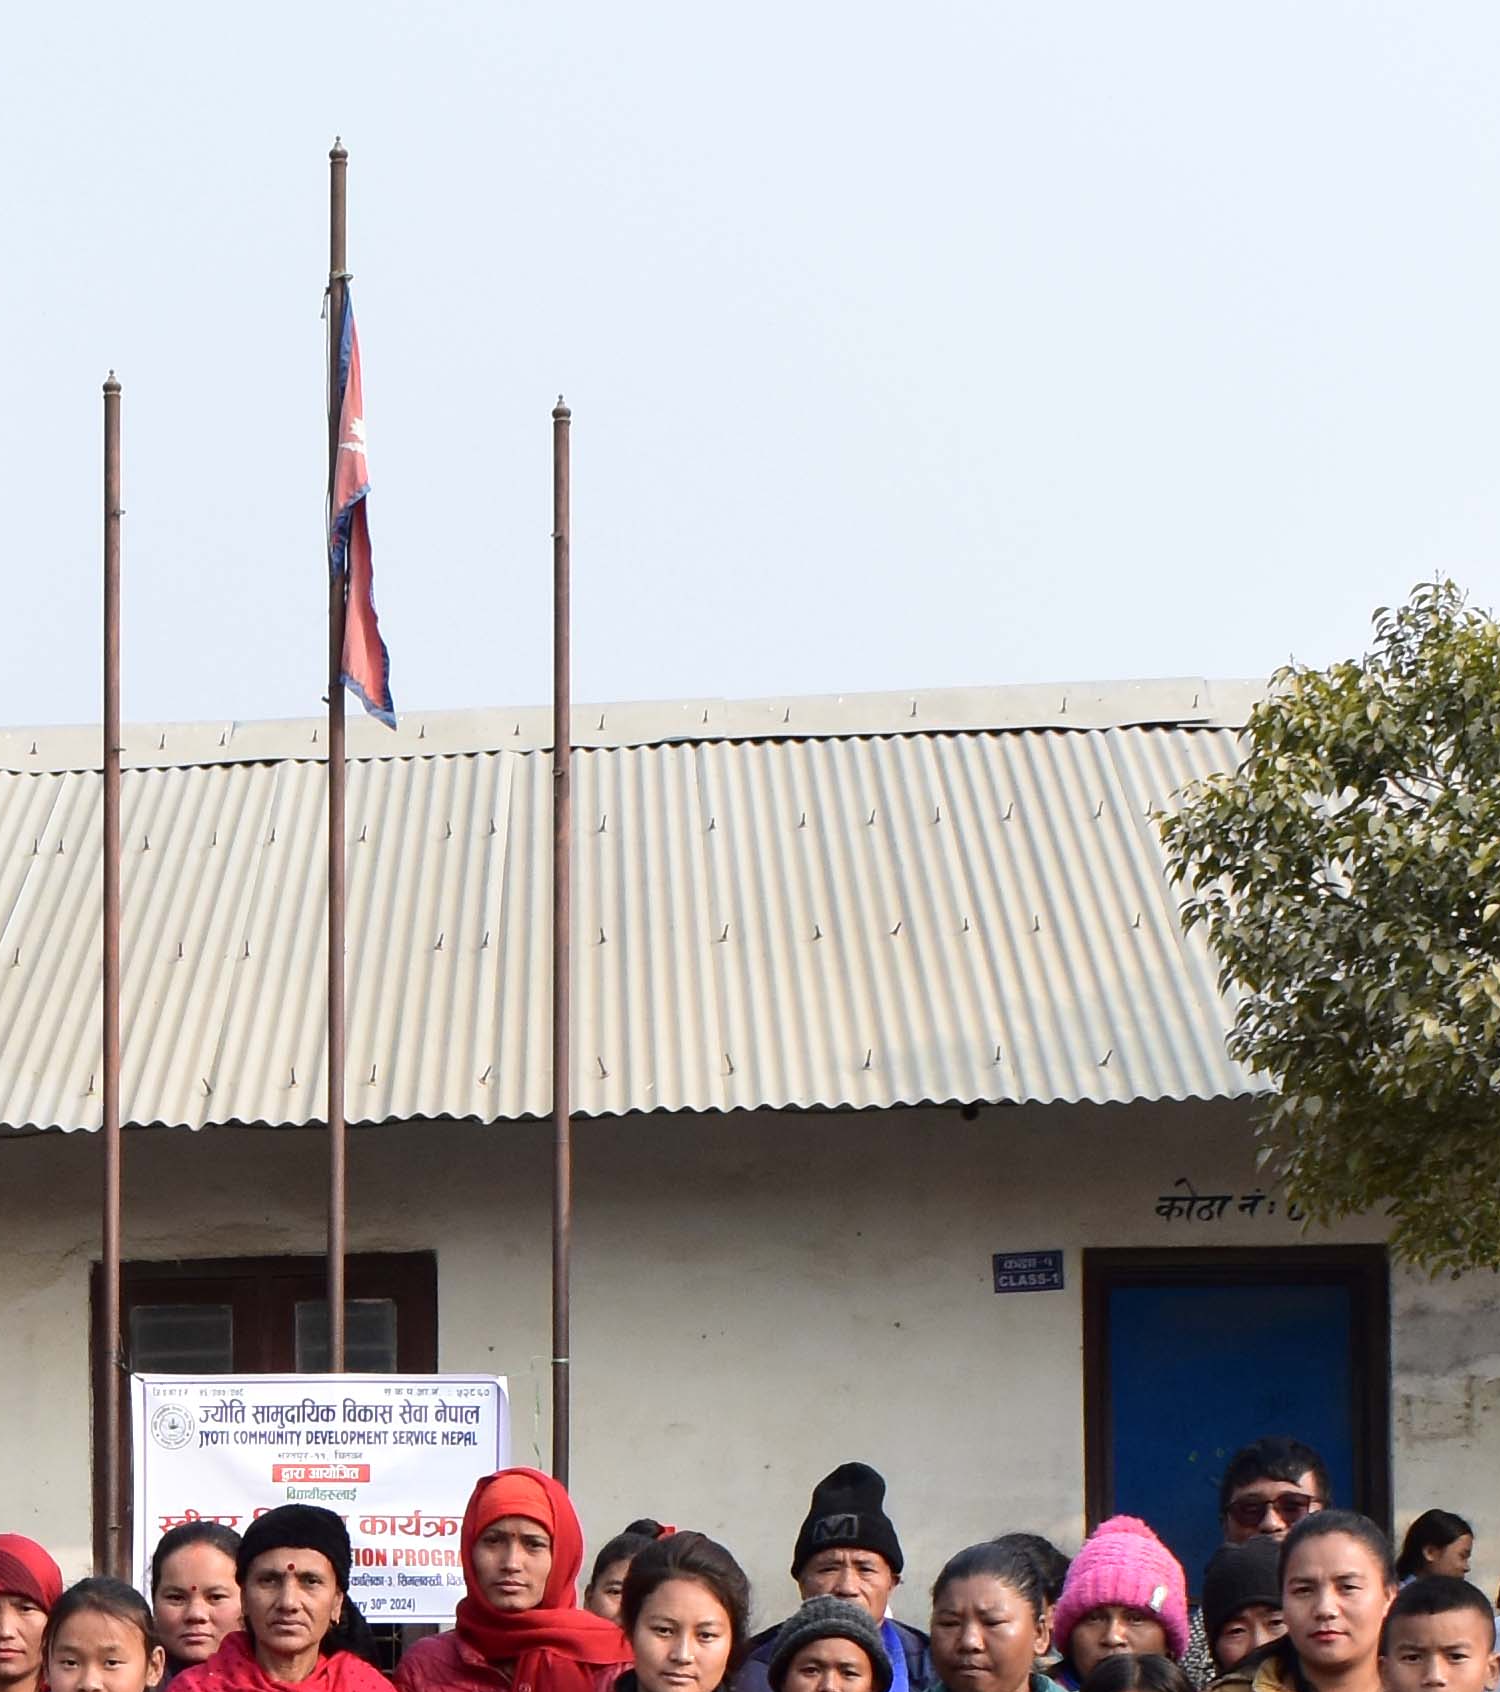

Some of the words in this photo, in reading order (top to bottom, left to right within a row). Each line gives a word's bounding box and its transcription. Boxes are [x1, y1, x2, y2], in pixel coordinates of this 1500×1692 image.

[1155, 1177, 1233, 1224] कोठा
[999, 1272, 1060, 1288] CLASS-1
[199, 1398, 246, 1424] ज्योति
[252, 1398, 336, 1429] सामुदायिक
[343, 1398, 393, 1425] विकास
[399, 1398, 428, 1425] सेवा
[435, 1398, 481, 1425] नेपाल
[199, 1430, 230, 1449] JYOTI
[233, 1430, 302, 1446] COMMUNITY
[306, 1430, 389, 1446] DEVELOPMENT
[392, 1430, 437, 1447] SERVICE
[441, 1431, 478, 1447] NEPAL
[281, 1466, 305, 1482] द्वारा
[308, 1464, 360, 1480] आयोजित
[359, 1510, 464, 1538] कार्यक्र
[390, 1598, 416, 1612] 2024)
